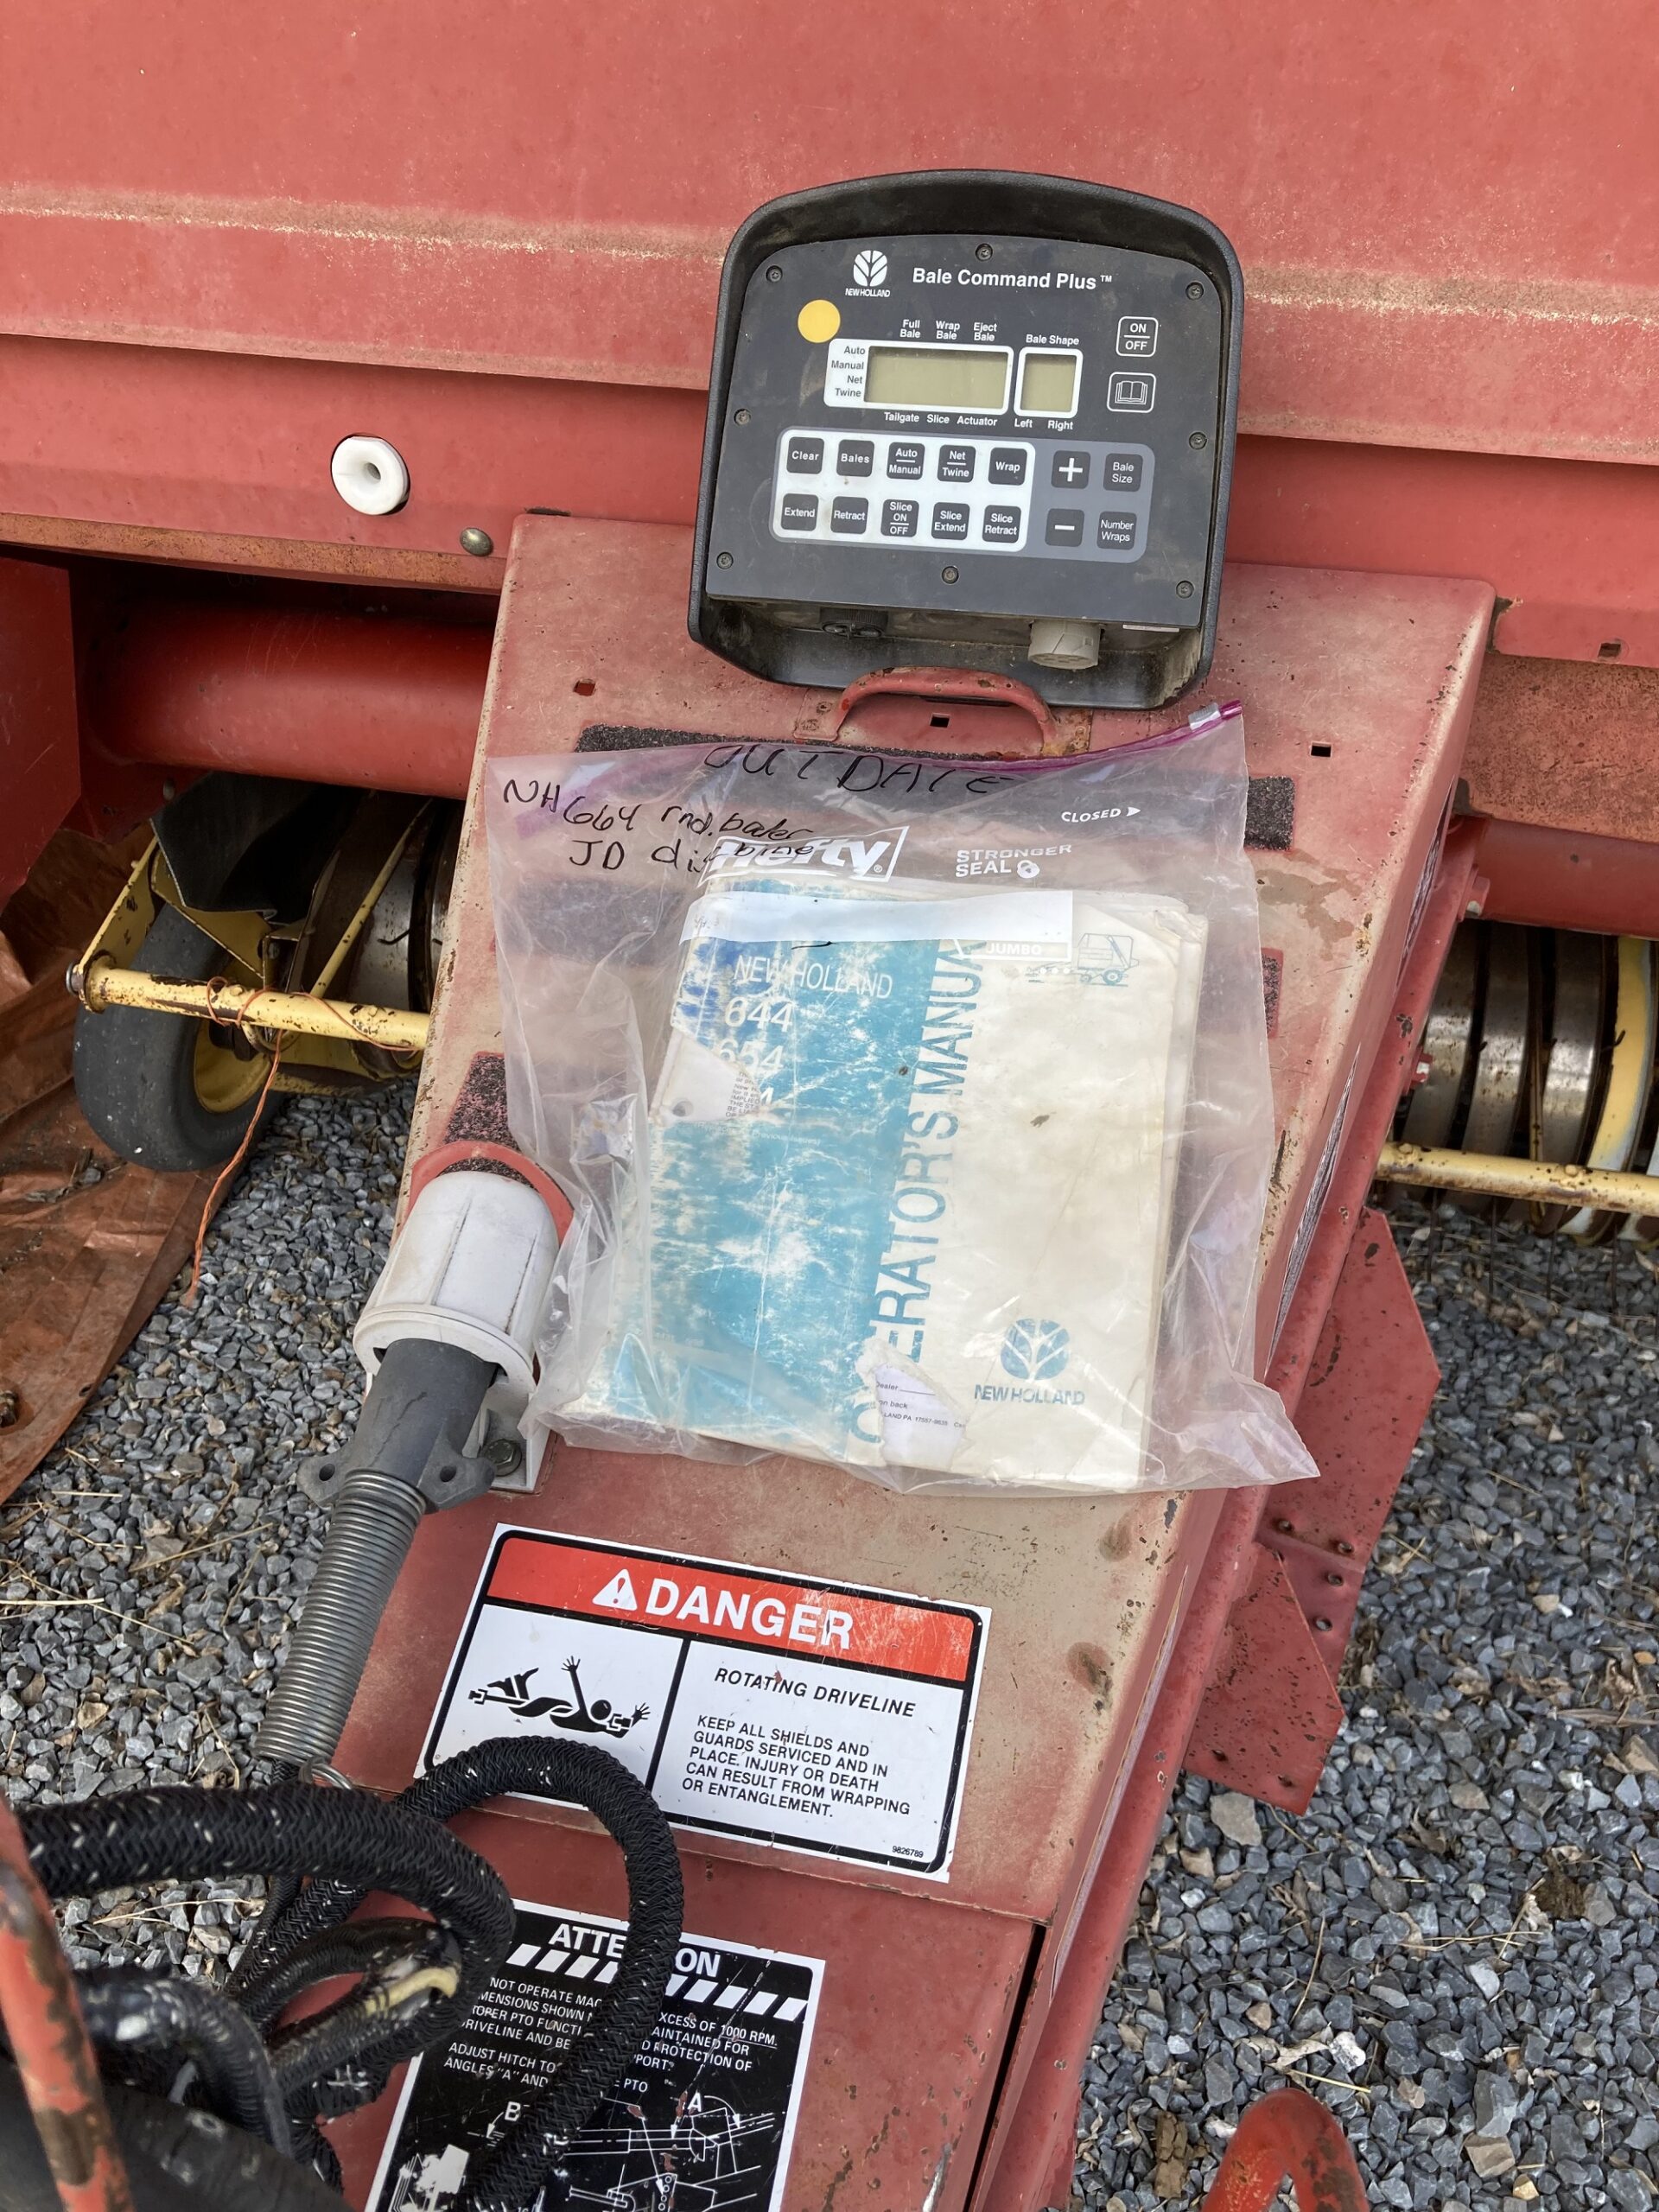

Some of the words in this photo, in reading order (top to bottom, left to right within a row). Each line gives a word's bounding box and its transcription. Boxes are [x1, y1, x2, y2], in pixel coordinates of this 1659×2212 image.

[912, 267, 952, 286] Bale
[957, 269, 1052, 289] Command
[845, 288, 860, 296] NEW
[860, 288, 891, 298] HOLLAND
[902, 319, 921, 329] Full
[935, 320, 961, 333] Wrap
[973, 322, 997, 334] Eject
[1129, 322, 1147, 334] ON
[899, 328, 921, 339] Bale
[936, 331, 957, 340] Bale
[974, 332, 995, 342] Bale
[1025, 334, 1047, 344] Bale
[1049, 334, 1080, 347] Shape
[1124, 340, 1148, 351] OFF
[843, 346, 866, 355] Auto
[830, 359, 865, 371] Manual
[847, 374, 863, 385] Net
[835, 388, 862, 397] Twine
[884, 411, 920, 424] Tailgate
[926, 413, 950, 424] Slice
[957, 415, 998, 427] Actuator
[1014, 418, 1033, 429] Left
[1047, 420, 1074, 432] Right
[791, 450, 820, 461] Clear
[841, 453, 871, 464] Bales
[895, 448, 918, 458] Auto
[949, 450, 967, 461] Net
[888, 464, 921, 475] Manual
[942, 467, 970, 478] Twine
[995, 461, 1020, 474] Wrap
[1112, 461, 1135, 472] Bale
[1111, 474, 1134, 484] Size
[784, 506, 817, 518] Extend
[889, 501, 913, 512] Slice
[833, 510, 867, 521] Retract
[893, 512, 908, 522] ON
[939, 510, 963, 520] Slice
[990, 512, 1014, 524] Slice
[889, 526, 909, 536] OFF
[934, 522, 967, 532] Extend
[983, 524, 1018, 536] Retract
[1100, 519, 1135, 531] Number
[1101, 531, 1131, 543] Wraps
[503, 779, 561, 813] NH
[563, 796, 642, 831] 664
[1061, 807, 1122, 823] CLOSED
[569, 839, 625, 871] JD
[956, 843, 1073, 864] STRONGER
[955, 861, 1013, 879] SEAL
[987, 942, 1043, 956] JUMBO
[794, 963, 893, 1000] HOLLAND
[847, 1109, 959, 1444] OERATOR'S
[912, 939, 988, 1096] MANUA
[974, 1383, 1009, 1402] NEW
[1010, 1388, 1086, 1406] HOLLAND
[645, 1577, 855, 1650] DANGER
[714, 1667, 808, 1698] ROTATING
[812, 1686, 917, 1718] DRIVELINE
[697, 1714, 735, 1732] KEEP
[739, 1722, 766, 1739] ALL
[770, 1728, 833, 1751] SHIELDS
[836, 1741, 870, 1758] AND
[693, 1731, 754, 1752] GUARDS
[758, 1742, 832, 1767] SERVICED
[835, 1757, 868, 1774] AND
[872, 1764, 888, 1778] IN
[690, 1746, 741, 1767] PLACE.
[745, 1756, 799, 1777] INJURY
[803, 1767, 824, 1783] OR
[829, 1772, 880, 1793] DEATH
[686, 1762, 718, 1780] CAN
[721, 1770, 778, 1790] RESULT
[781, 1779, 826, 1800] FROM
[830, 1789, 911, 1816] WRAPPING
[682, 1777, 703, 1793] OR
[708, 1783, 834, 1818] ENTANGLEMENT.
[892, 1845, 925, 1859] 9826789
[489, 1976, 516, 1992] NOT
[518, 1982, 574, 2004] OPERATE
[658, 2012, 696, 2029] XCESS
[699, 2020, 716, 2032] OF
[721, 2024, 747, 2039] 1000
[749, 2031, 778, 2046] RPM.
[478, 1991, 540, 2012] MENSIONS
[541, 2003, 586, 2023] SHOWN
[651, 2026, 721, 2050] AINTAINED
[724, 2040, 750, 2056] FOR
[461, 2018, 524, 2040] RIVELINE
[524, 2031, 554, 2046] AND
[509, 2012, 534, 2026] PTO
[537, 2018, 582, 2035] FUNCTI
[734, 2058, 753, 2072] OF
[443, 2056, 495, 2077] ANGLES
[520, 2072, 549, 2088] AND
[448, 2042, 497, 2061] ADJUST
[498, 2050, 537, 2070] HITCH
[623, 2077, 649, 2093] PTO
[687, 2089, 703, 2113] A
[504, 2101, 522, 2122] B
